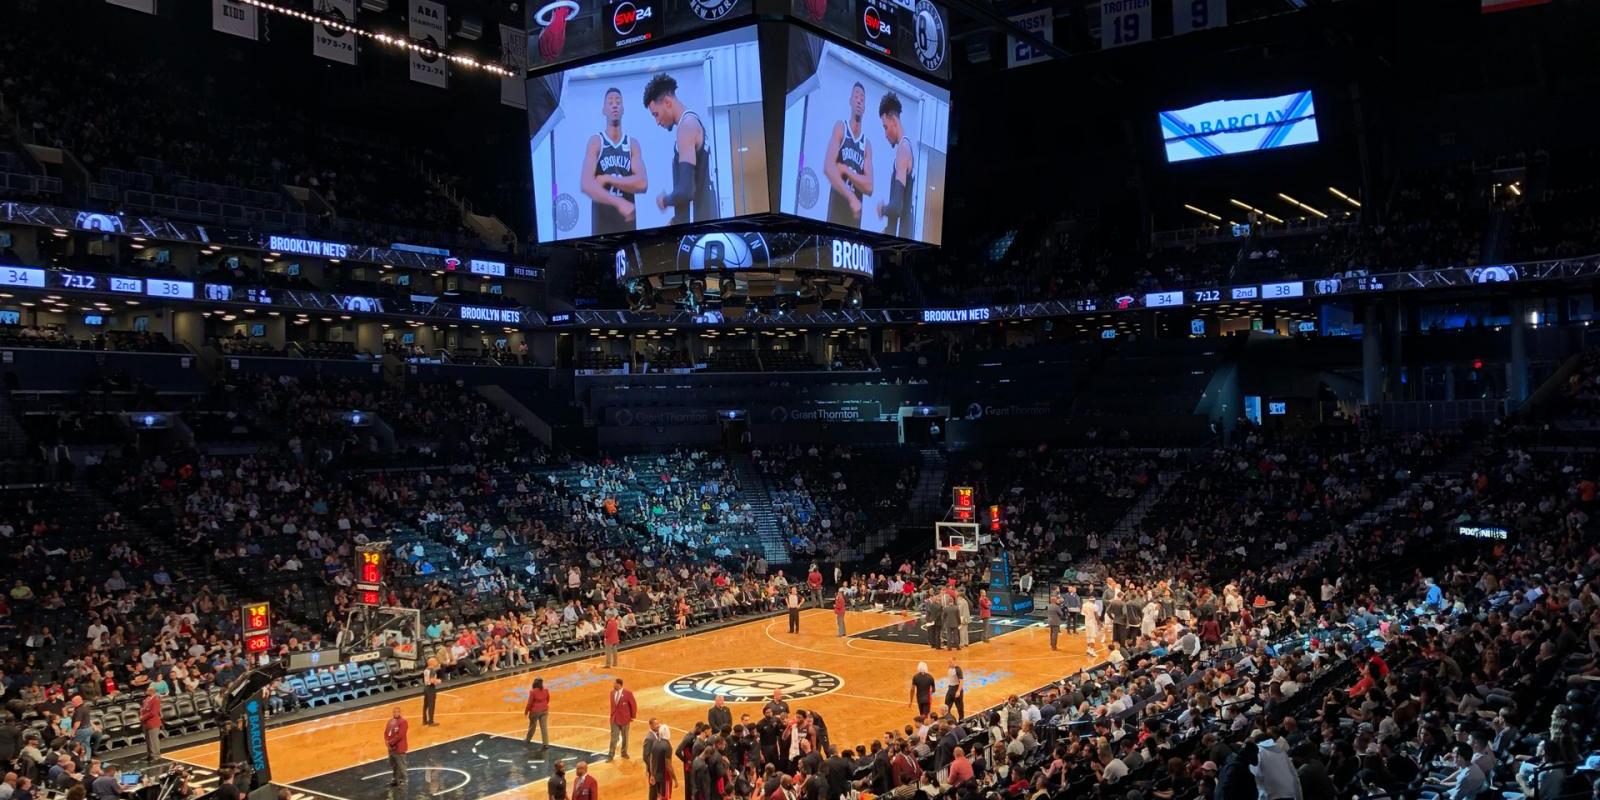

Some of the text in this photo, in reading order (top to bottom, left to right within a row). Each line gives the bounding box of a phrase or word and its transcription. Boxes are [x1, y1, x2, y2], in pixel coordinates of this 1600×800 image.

[223, 4, 245, 20] KIDD
[417, 5, 438, 19] ABA
[1191, 0, 1208, 28] 9
[1113, 14, 1140, 44] 19
[270, 236, 346, 257] BROOKLYN NETS
[8, 270, 28, 283] 34
[62, 274, 96, 289] 7:12
[115, 279, 136, 291] 2nd
[162, 283, 180, 296] 38
[1275, 285, 1291, 296] 38
[1158, 294, 1173, 304] 34
[1195, 290, 1220, 302] 7:12
[1236, 289, 1253, 298] 2nd
[461, 306, 520, 323] BROOKLYN NETS
[924, 308, 990, 322] BROOKLYN NETS
[791, 408, 860, 419] Grant Thornton
[249, 716, 265, 771] BARCLAYS
